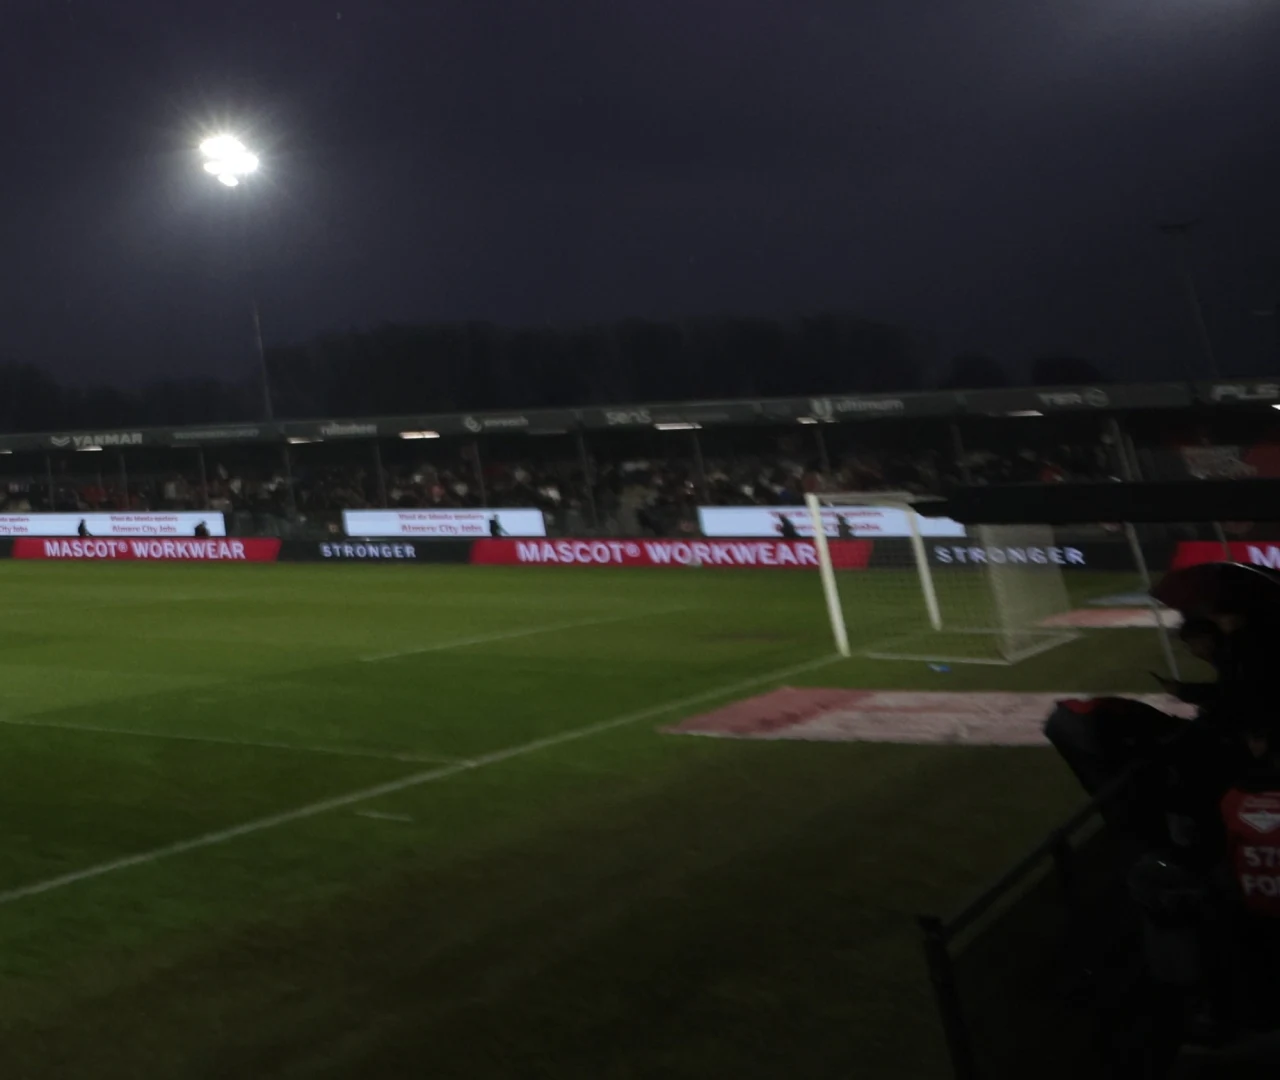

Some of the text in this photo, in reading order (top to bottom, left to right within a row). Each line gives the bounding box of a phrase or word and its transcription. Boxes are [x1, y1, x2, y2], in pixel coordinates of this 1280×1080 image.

[73, 433, 143, 447] YANMAR
[130, 540, 247, 560] WORKWEAR
[320, 544, 417, 559] STRONGER
[643, 542, 822, 567] WORKWEAR
[934, 545, 1087, 565] STRONGER
